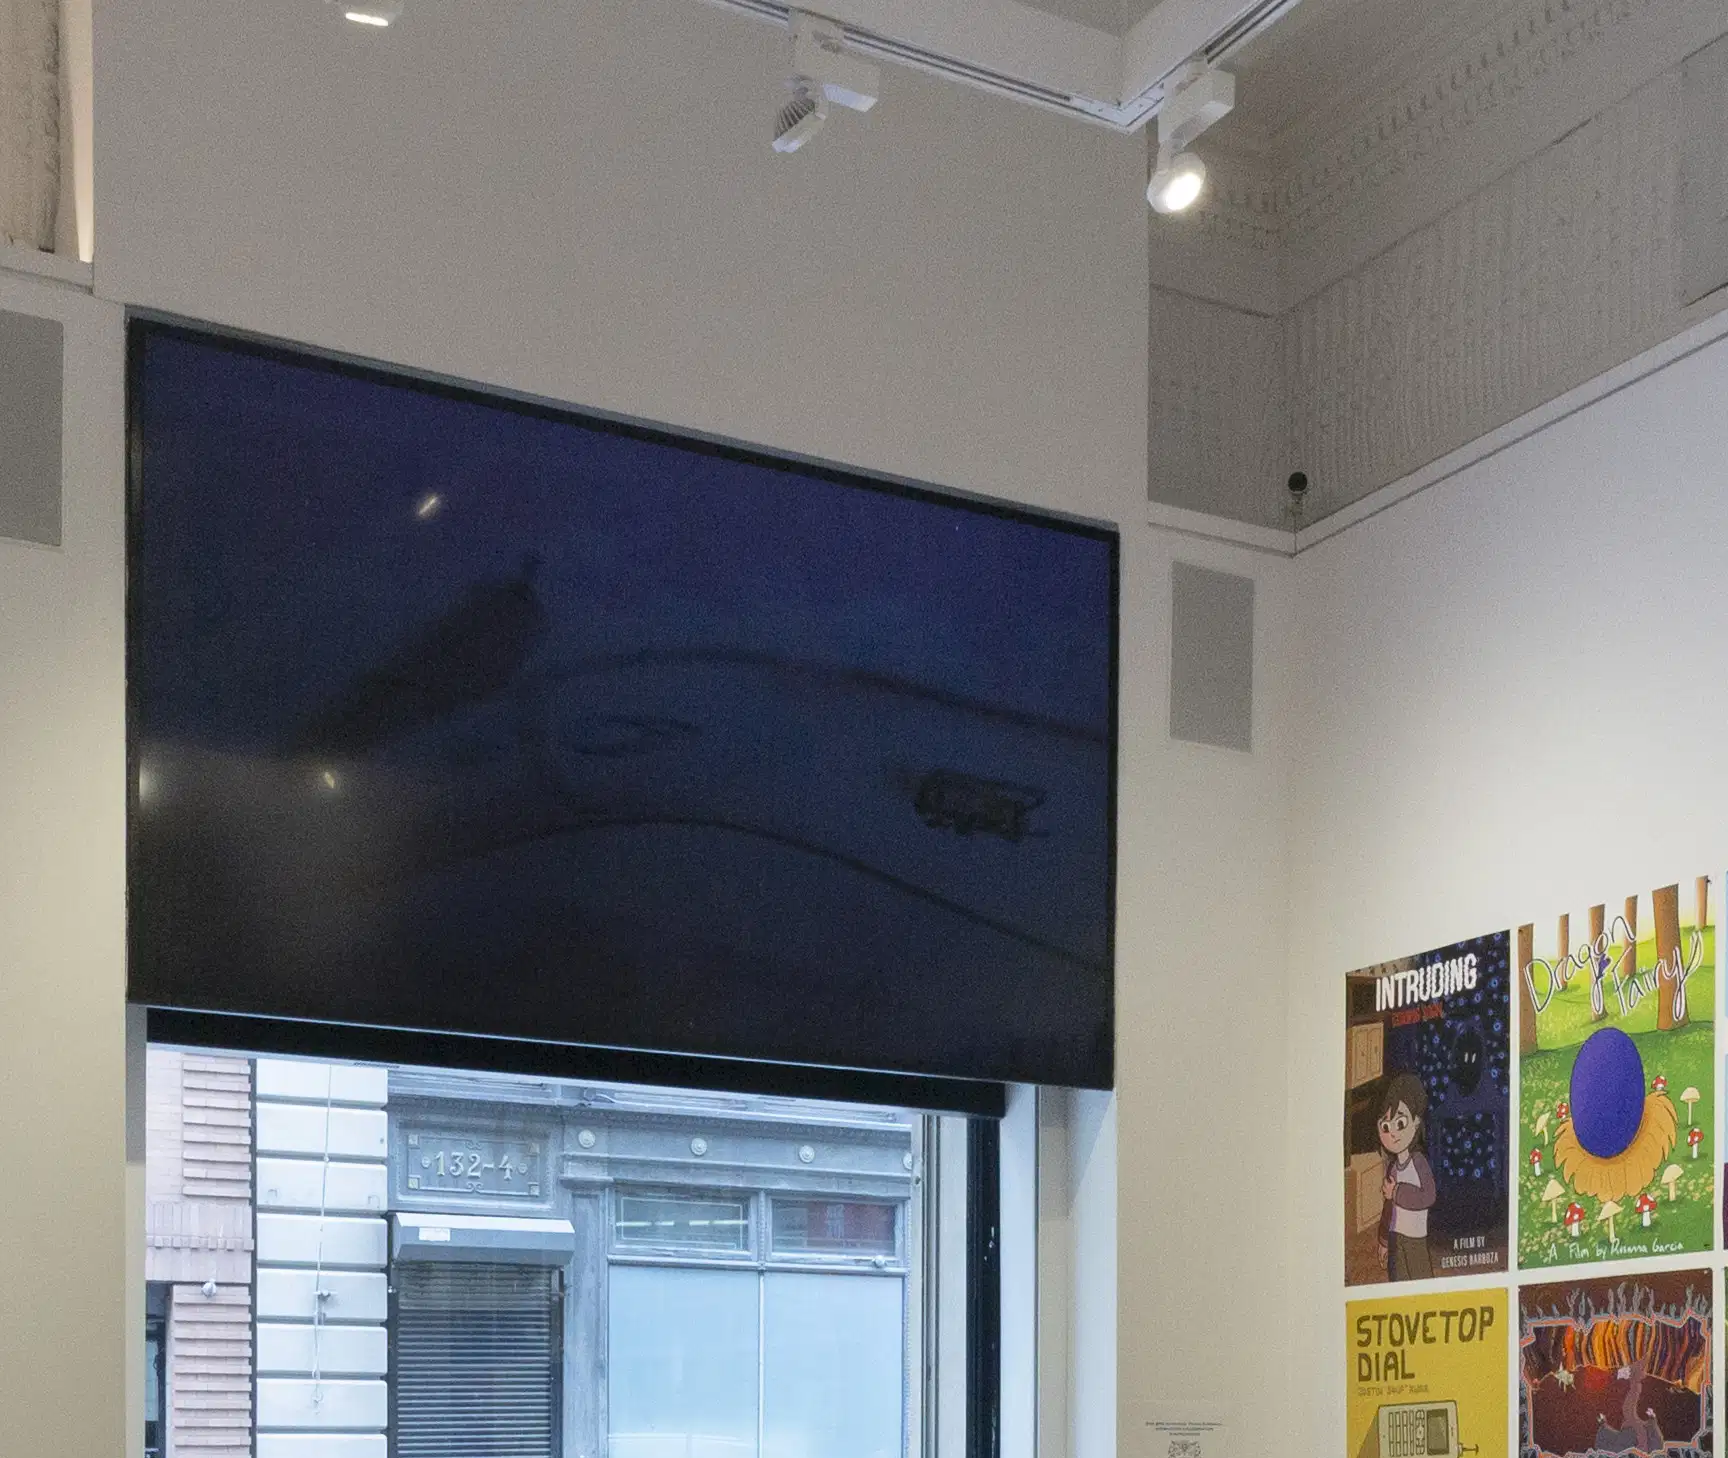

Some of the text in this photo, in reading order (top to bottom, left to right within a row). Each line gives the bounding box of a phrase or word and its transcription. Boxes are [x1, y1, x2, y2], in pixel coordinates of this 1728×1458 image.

[1375, 953, 1477, 1012] INTRUDING
[1524, 915, 1636, 1014] Dragon
[1612, 930, 1703, 1021] Fairy
[433, 1149, 513, 1181] 132-4
[1453, 1236, 1485, 1250] A FILM BY
[1549, 1243, 1558, 1262] A
[1569, 1242, 1589, 1259] Film
[1596, 1244, 1607, 1259] by
[1652, 1238, 1684, 1252] Garcia
[1356, 1305, 1494, 1347] STOVETOP
[1358, 1349, 1415, 1382] DIAL
